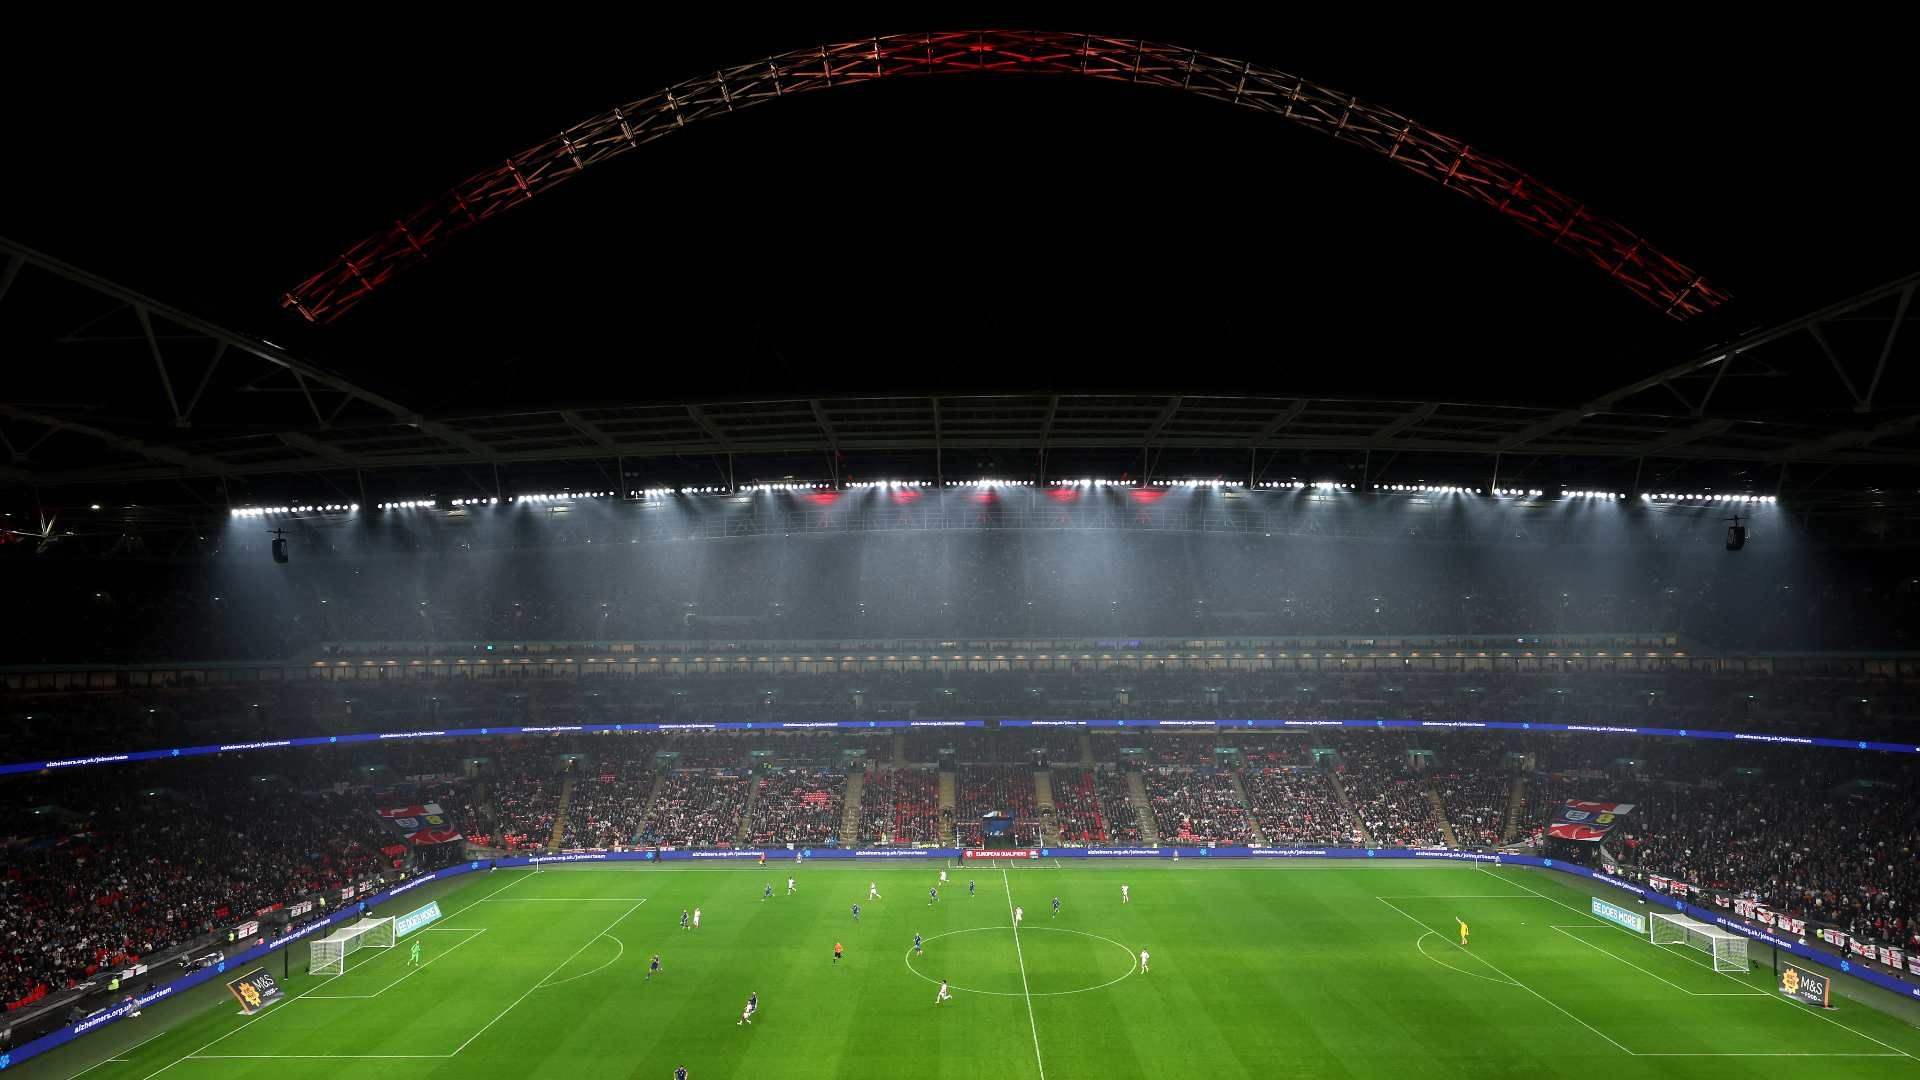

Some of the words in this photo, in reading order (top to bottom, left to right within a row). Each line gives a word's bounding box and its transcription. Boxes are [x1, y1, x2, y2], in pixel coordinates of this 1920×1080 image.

[46, 756, 129, 768] alzheimers.org.uk/joinourteam
[1593, 900, 1602, 913] EE
[1602, 904, 1618, 920] DOES
[1619, 910, 1636, 928] MORE
[252, 974, 274, 991] M&S
[1800, 976, 1823, 995] M&S
[1804, 990, 1818, 1001] FOOD
